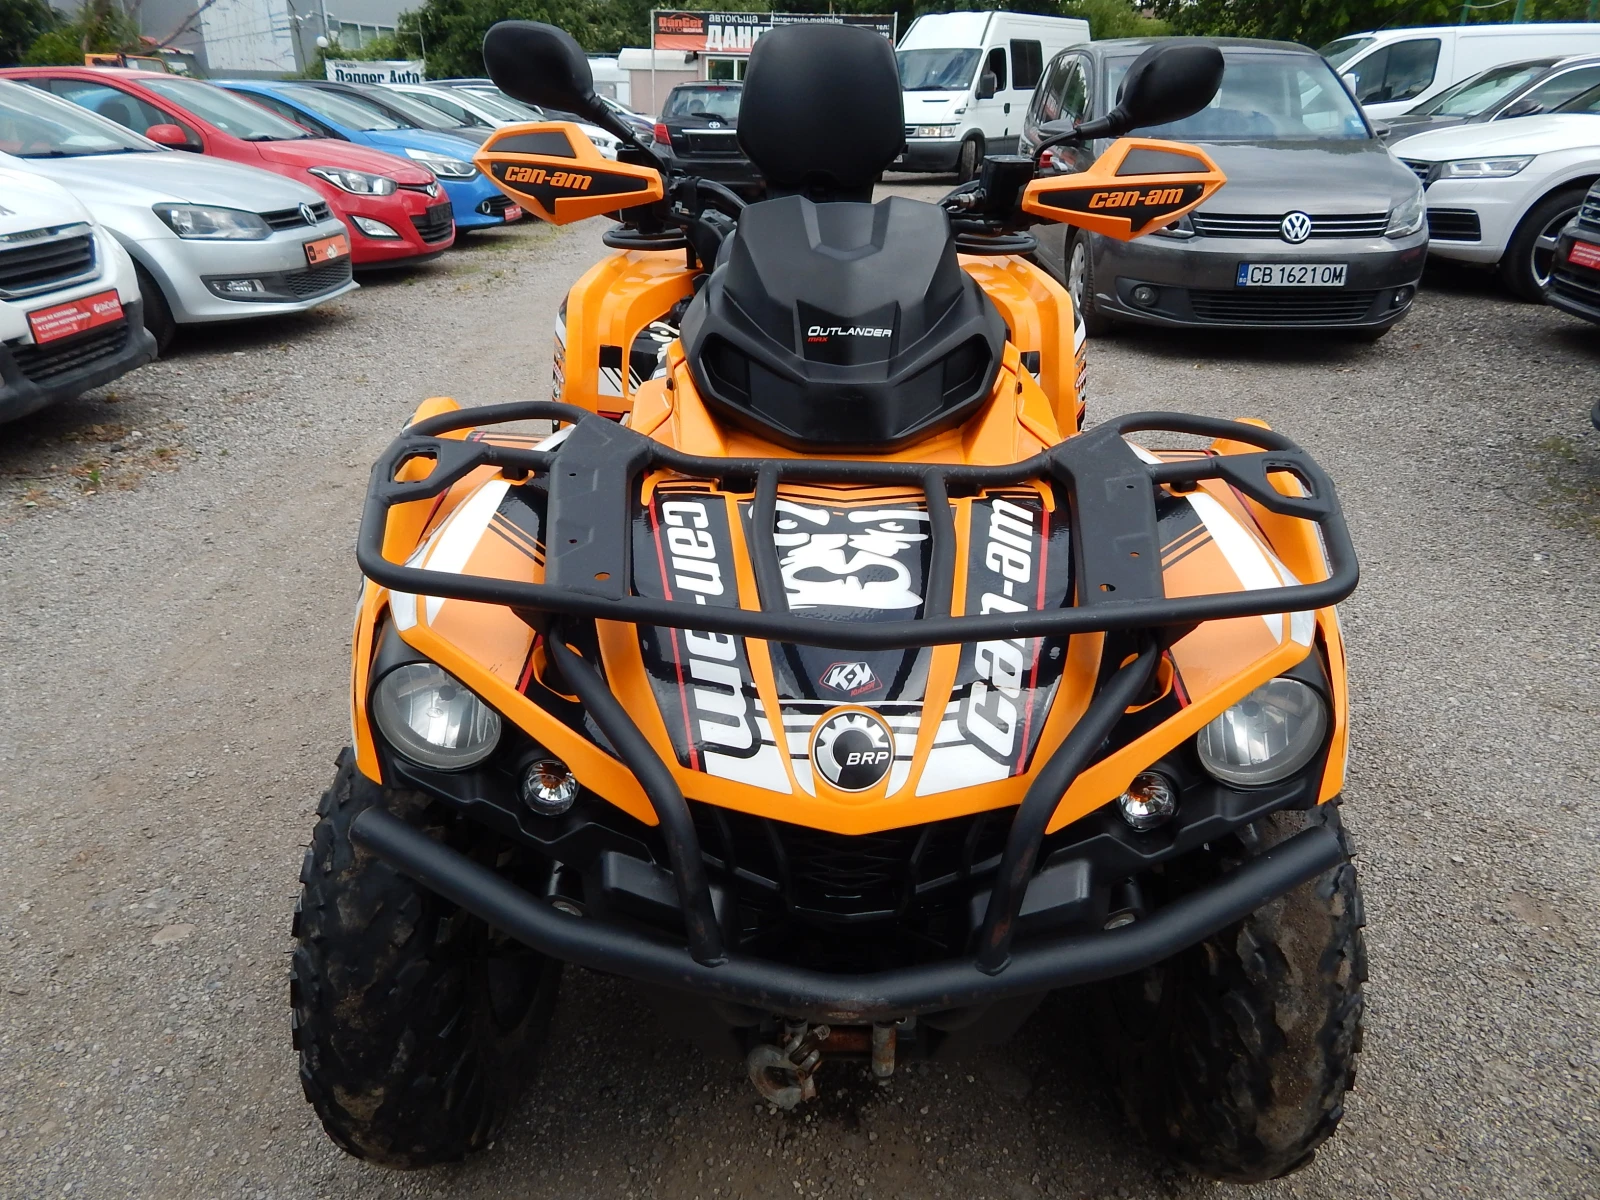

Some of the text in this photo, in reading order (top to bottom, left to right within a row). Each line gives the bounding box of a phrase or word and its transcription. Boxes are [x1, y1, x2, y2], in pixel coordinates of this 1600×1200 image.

[708, 14, 759, 24] автокъща
[705, 25, 775, 51] ДАНГ
[504, 165, 592, 191] can-am
[1088, 187, 1184, 209] can-am
[1279, 266, 1317, 284] 1621
[845, 751, 889, 766] BRP
